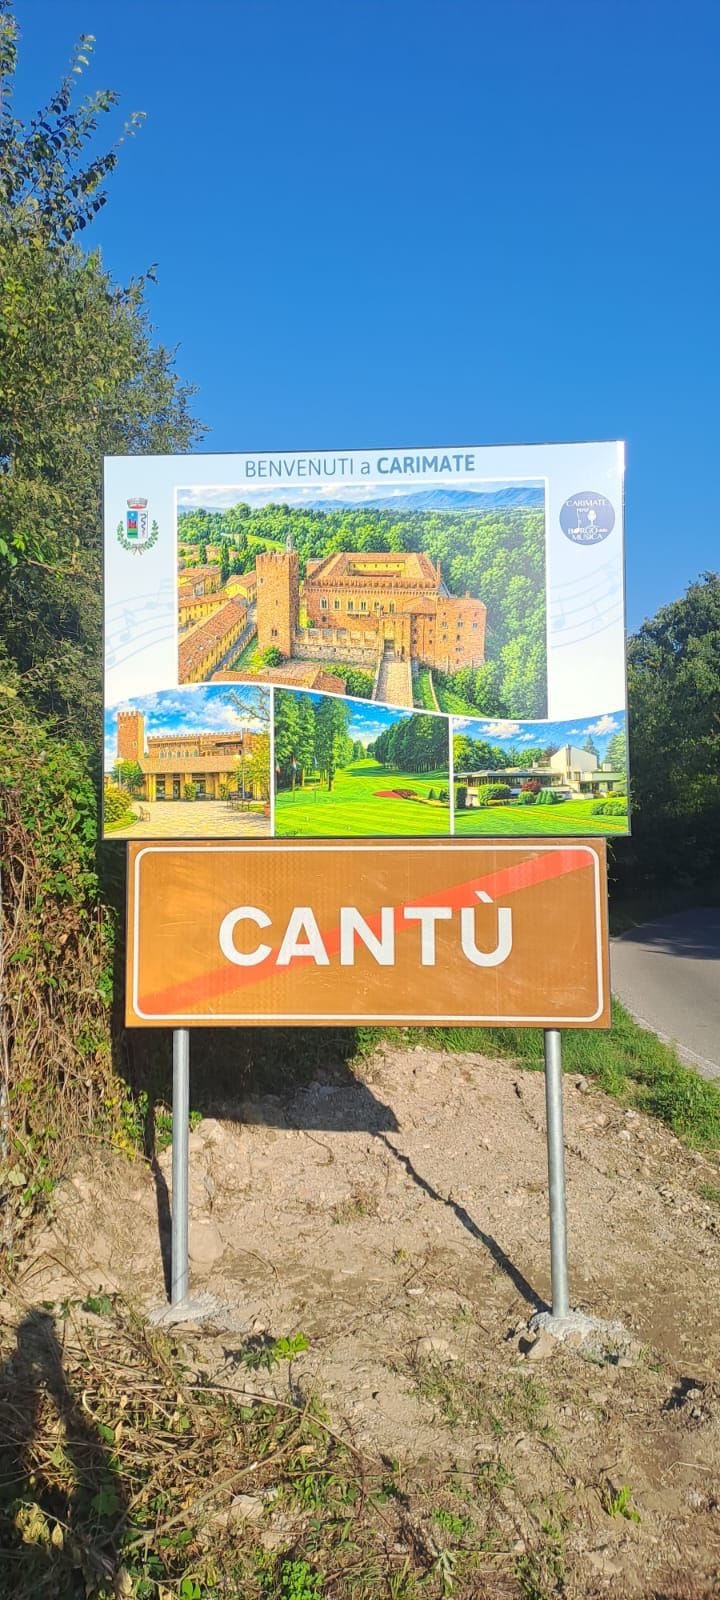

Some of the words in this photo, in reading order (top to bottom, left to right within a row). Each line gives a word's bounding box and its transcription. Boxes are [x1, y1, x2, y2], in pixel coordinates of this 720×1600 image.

[245, 458, 354, 477] BENVENUTI
[360, 461, 371, 475] a
[377, 454, 475, 474] CARIMATE
[566, 499, 609, 507] CARIMATE
[218, 890, 513, 967] CANTÙ
